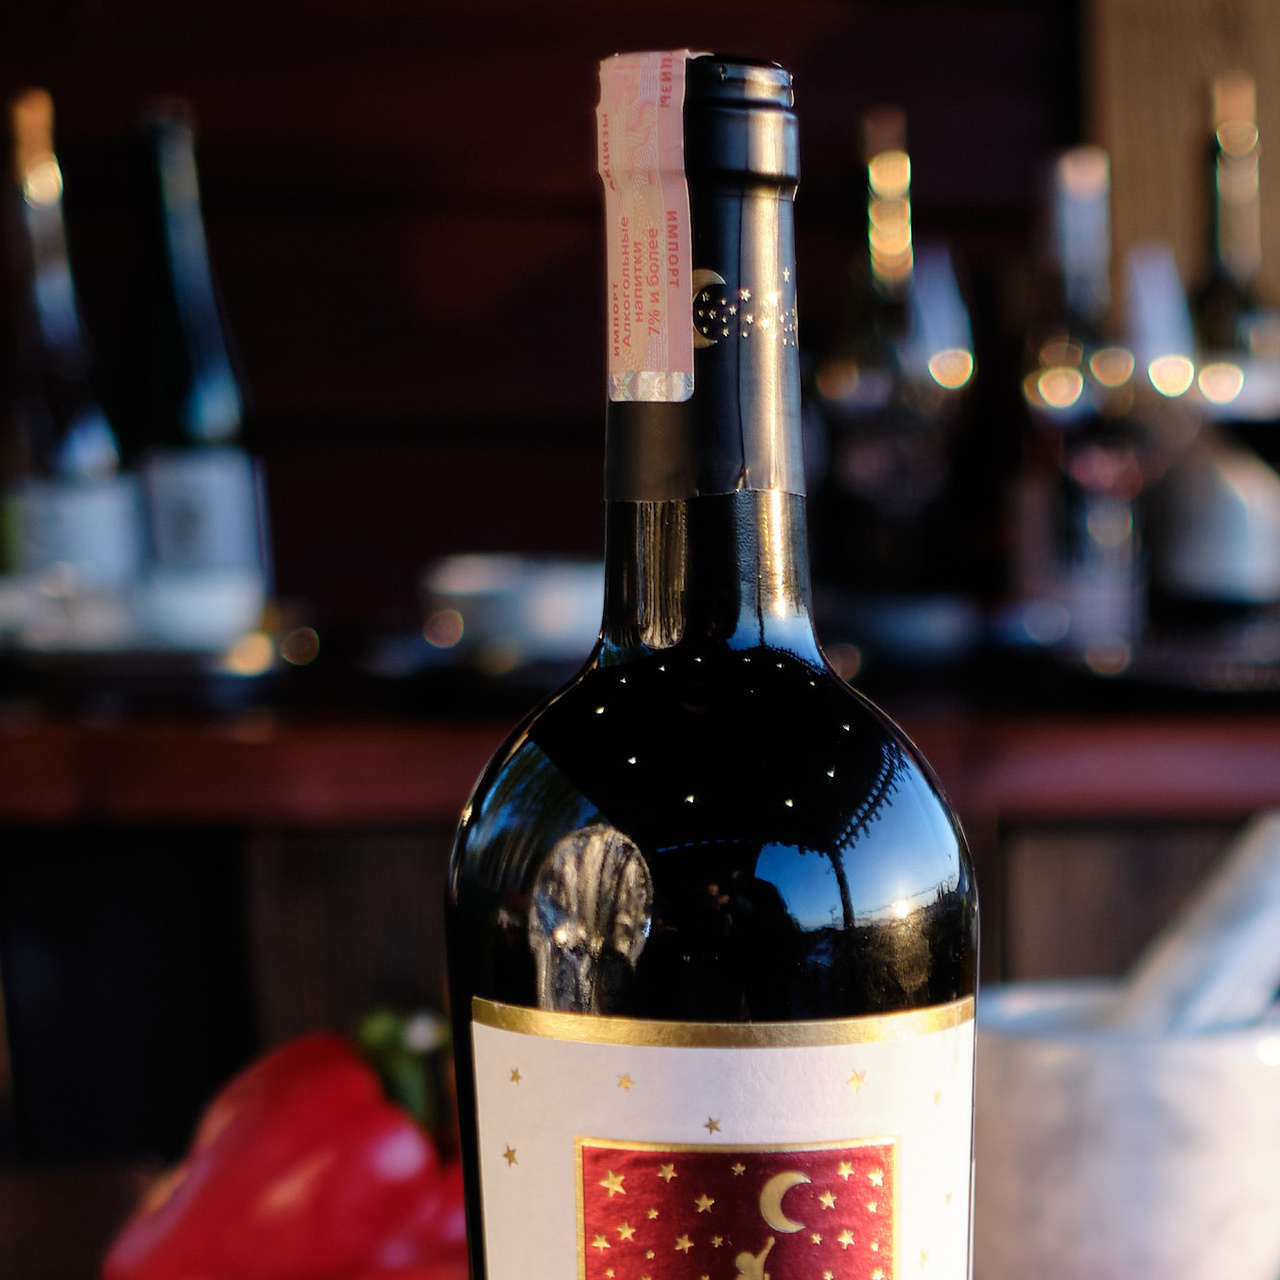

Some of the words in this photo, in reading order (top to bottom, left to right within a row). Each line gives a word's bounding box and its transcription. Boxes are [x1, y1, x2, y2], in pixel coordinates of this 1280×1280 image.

[659, 52, 672, 108] ЦИЗЫ
[602, 113, 615, 191] АКЦИЗЫ
[620, 216, 632, 348] Алкогольные
[633, 241, 644, 323] напитки
[645, 227, 660, 287] более
[666, 209, 680, 288] ИМПОРТ
[612, 282, 620, 358] ИМПОРТ
[647, 309, 661, 337] 7%
[648, 291, 660, 304] и
